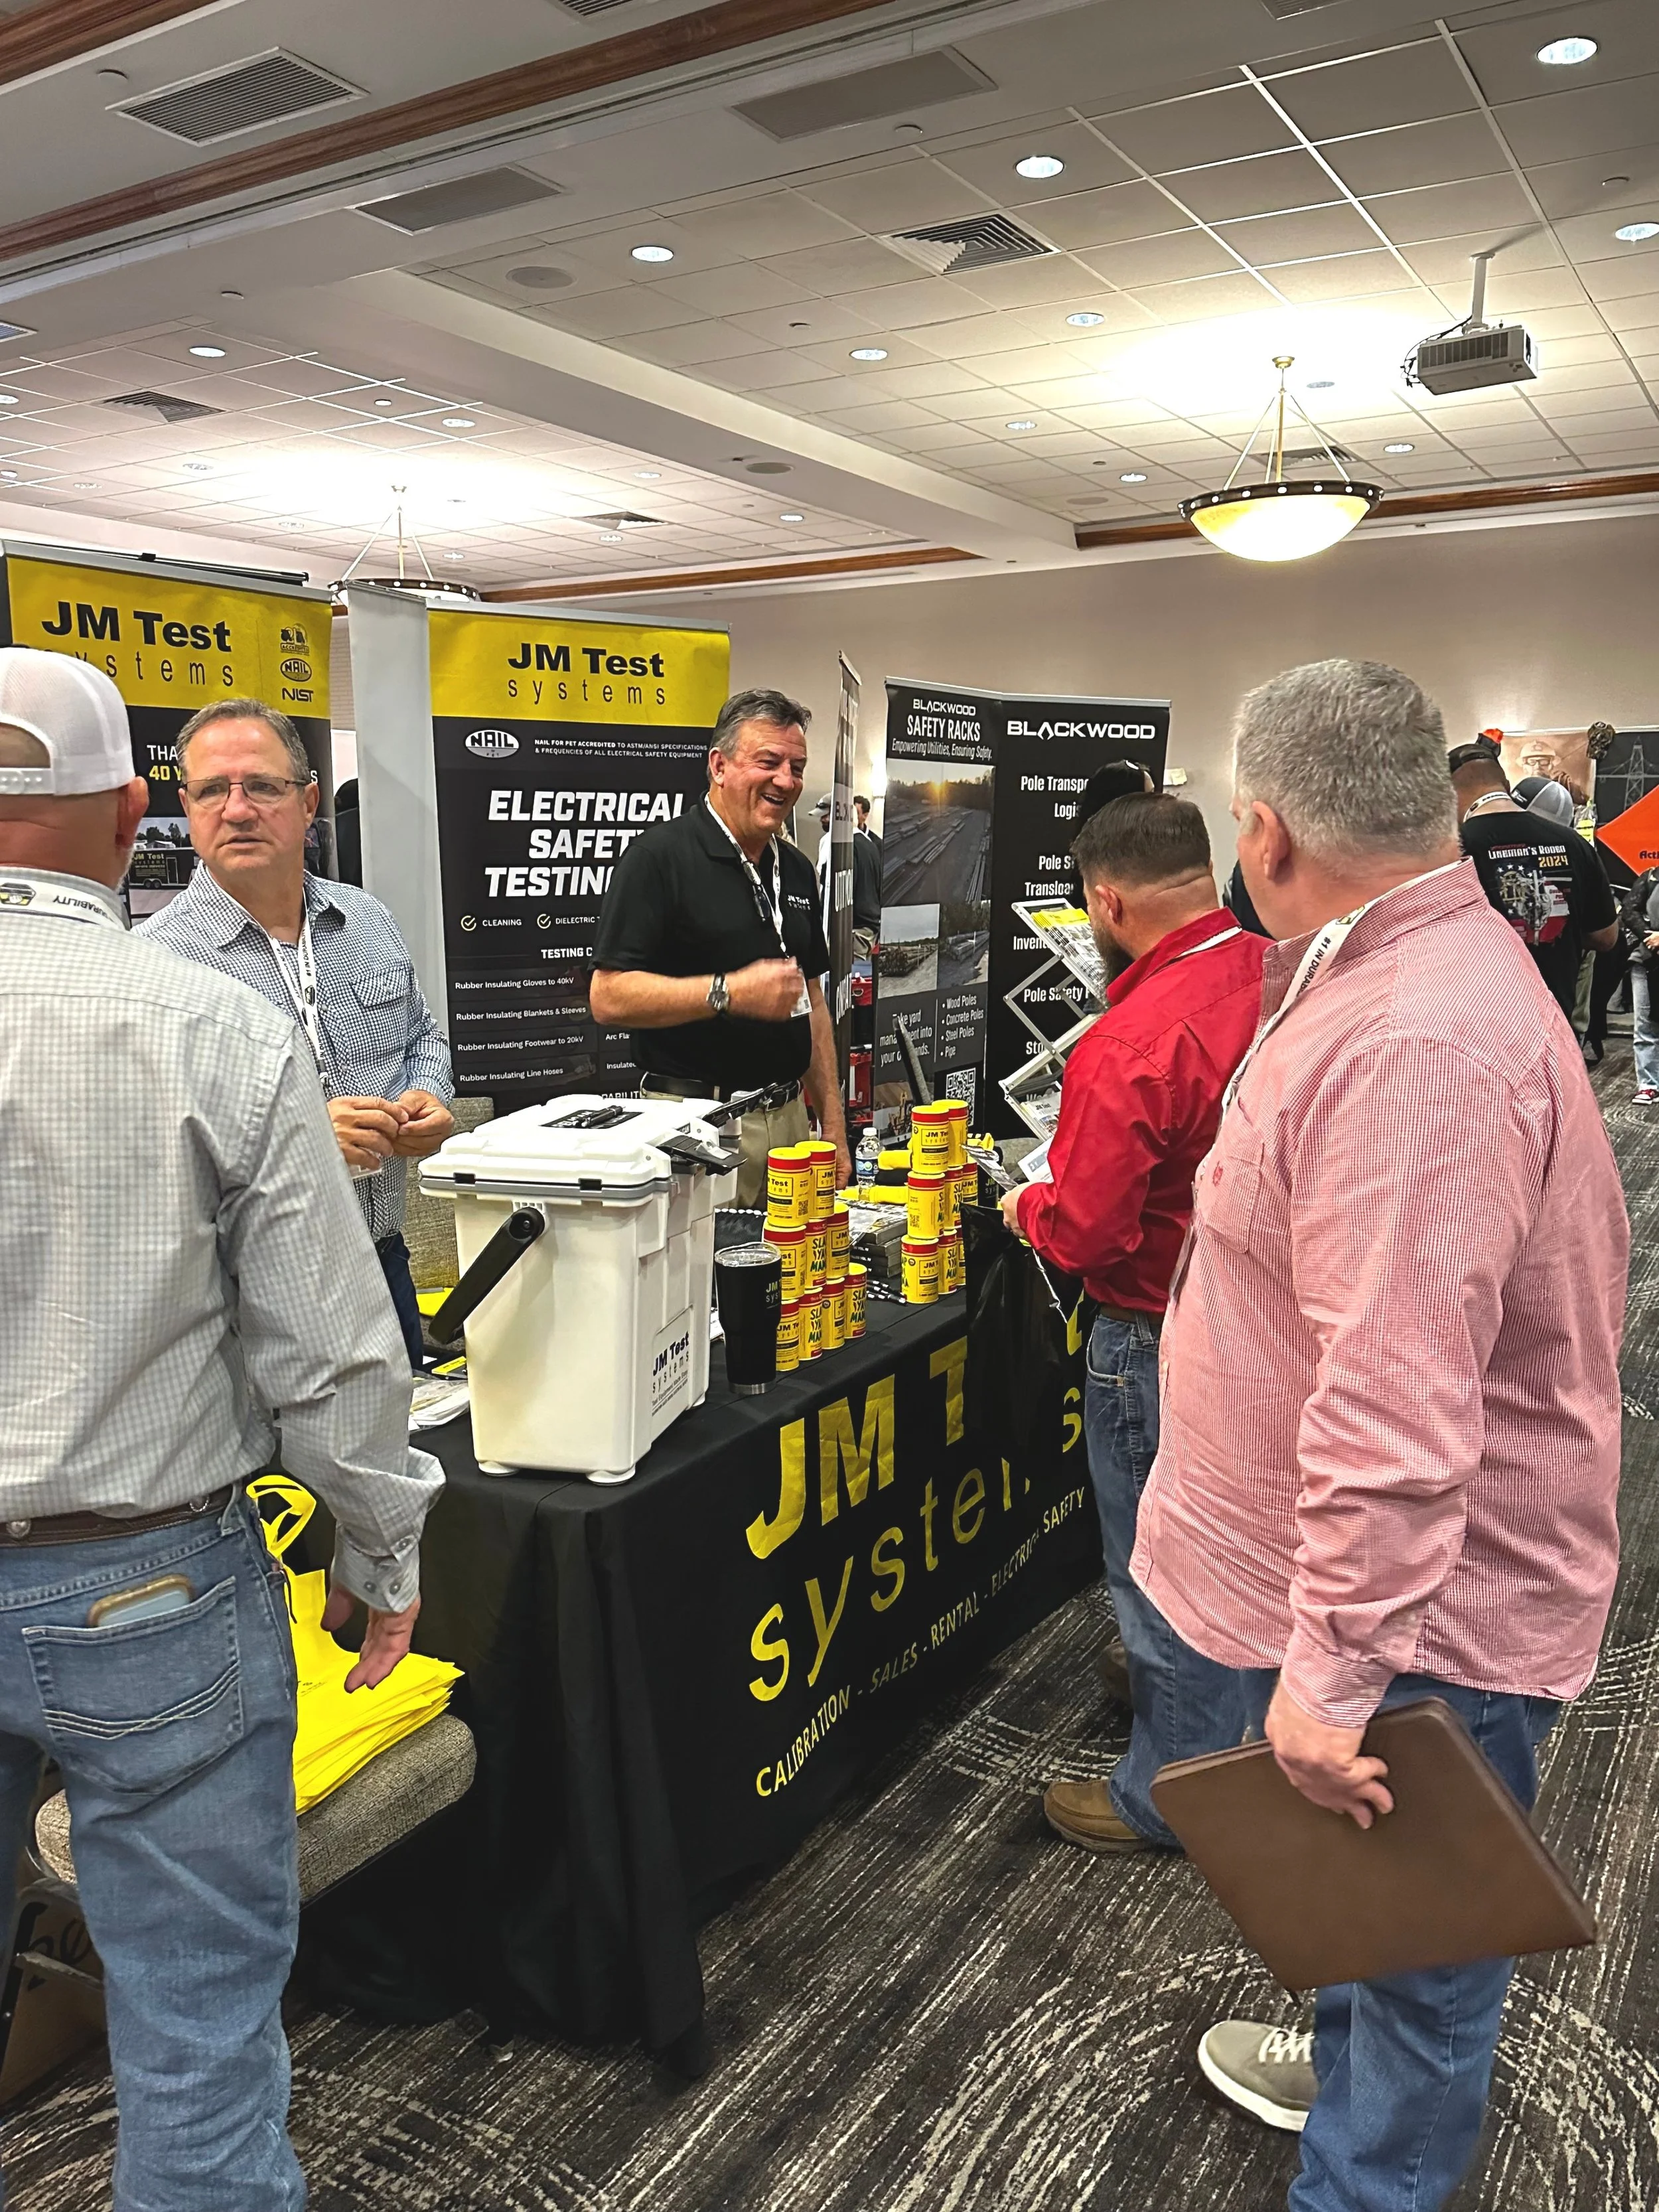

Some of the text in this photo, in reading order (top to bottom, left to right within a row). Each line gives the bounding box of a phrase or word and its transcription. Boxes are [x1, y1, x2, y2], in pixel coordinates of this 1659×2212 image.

[42, 601, 232, 652] JM Test
[44, 648, 233, 687] stems
[285, 661, 309, 674] NAIL
[508, 642, 664, 678] JM Test
[281, 687, 313, 702] NIST
[508, 678, 666, 706] systems
[913, 698, 976, 716] BLACKWOOD
[907, 714, 981, 742] SAFETY RACKS
[1007, 720, 1156, 741] BLACKWOOD
[470, 731, 514, 748] NAIL
[147, 745, 178, 761] THA
[892, 738, 992, 761] Empowering Utilities, Ensuring Safety.
[149, 765, 181, 780] 40 Y
[1021, 775, 1045, 791] Pole
[488, 790, 684, 823] ELECTRICAL
[1039, 855, 1074, 870] Pole S
[1538, 855, 1569, 868] 2024
[485, 867, 614, 897] TESTIN
[1025, 881, 1074, 896] Transloa
[541, 947, 593, 959] TESTING C
[1297, 936, 1332, 997] #1 IN DURAB
[485, 980, 521, 989] Insulating
[946, 994, 977, 1009] Wood Poles
[1024, 988, 1046, 1003] Pole
[486, 1011, 522, 1020] Insulating
[524, 1009, 553, 1017] Blankets
[909, 1009, 921, 1027] yard
[946, 1008, 983, 1025] Concrete Poles
[920, 1026, 932, 1039] into
[946, 1026, 974, 1041] Steel Poles
[487, 1041, 523, 1050] Insulating
[525, 1039, 556, 1047] Footwear
[944, 1045, 956, 1059] Pipe
[881, 1051, 895, 1067] your
[489, 1071, 525, 1081] Insulating
[771, 1178, 788, 1187] Test
[812, 1236, 826, 1249] SLA
[765, 1281, 778, 1293] JM
[765, 1292, 778, 1303] sys
[853, 1290, 865, 1301] SLA
[810, 1307, 822, 1320] SLA
[653, 1330, 689, 1376] JM Test
[652, 1351, 689, 1394] systems
[746, 1373, 896, 1560] JM
[756, 1684, 851, 1797] CALIBRATION
[869, 1642, 918, 1694] SALES
[931, 1591, 979, 1651] RENTAL
[1043, 1486, 1084, 1534] SAFETY
